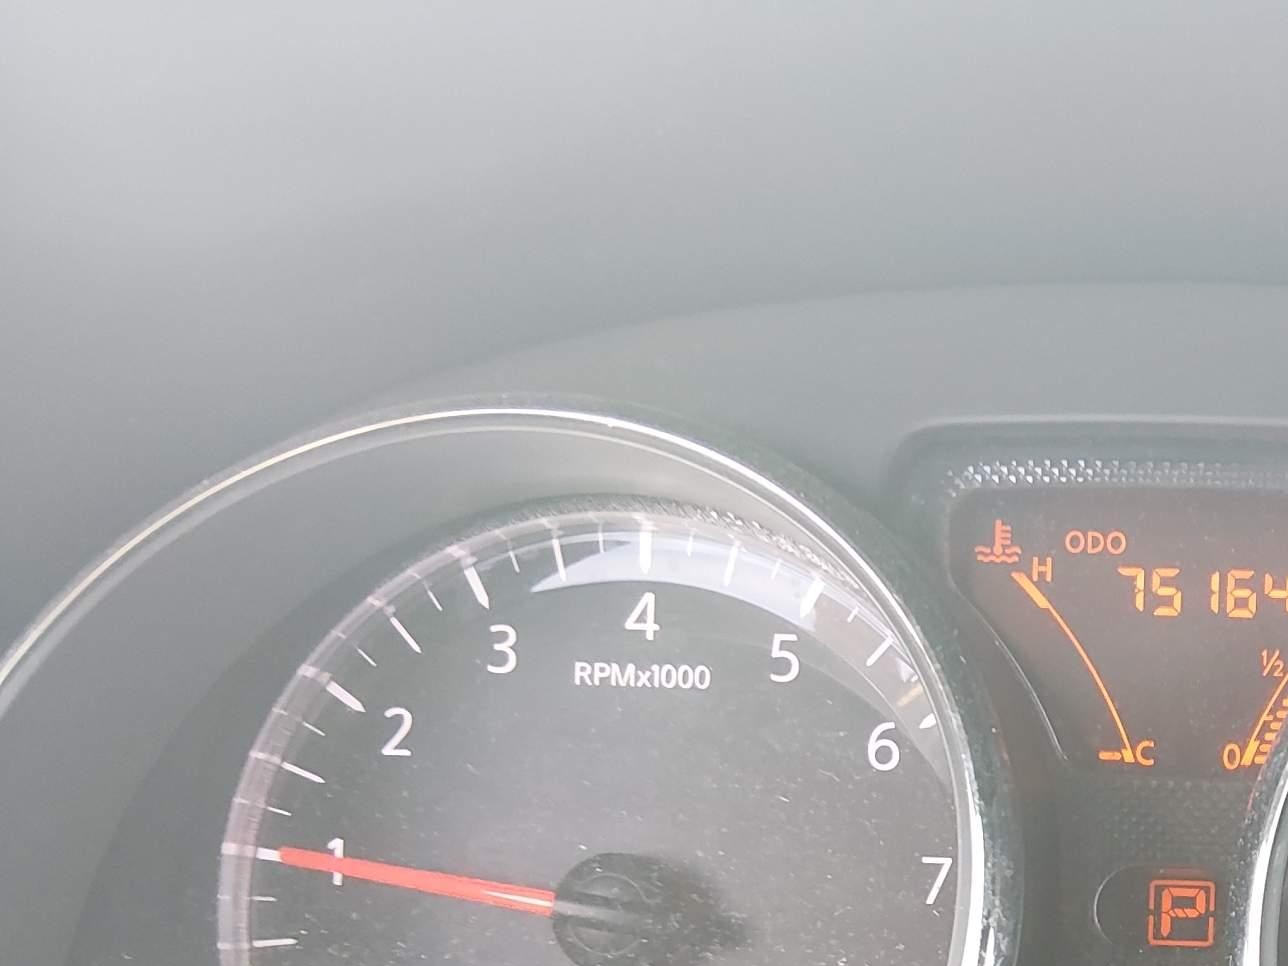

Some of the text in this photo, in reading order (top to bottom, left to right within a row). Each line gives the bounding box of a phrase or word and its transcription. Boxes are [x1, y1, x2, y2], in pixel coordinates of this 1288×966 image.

[1064, 529, 1127, 556] ODO
[1031, 556, 1053, 582] H
[624, 592, 661, 640] 4
[486, 624, 518, 674] 3
[769, 634, 801, 683] 5
[573, 661, 712, 691] RPMx1000
[380, 708, 413, 757] 2
[867, 722, 900, 771] 6
[1135, 740, 1155, 766] C
[326, 838, 344, 886] 1
[921, 856, 953, 905] 7
[1159, 886, 1206, 938] P
